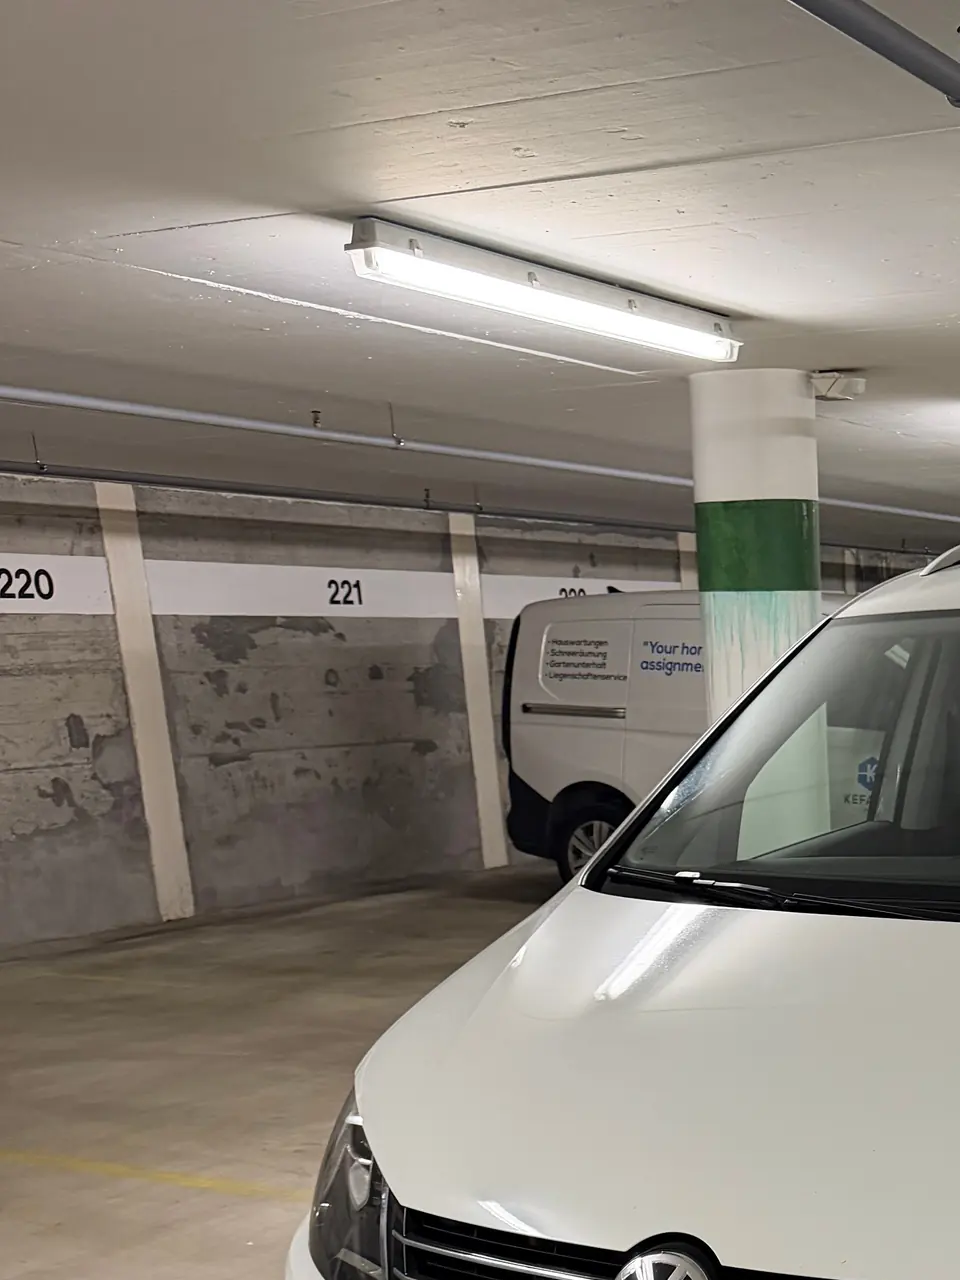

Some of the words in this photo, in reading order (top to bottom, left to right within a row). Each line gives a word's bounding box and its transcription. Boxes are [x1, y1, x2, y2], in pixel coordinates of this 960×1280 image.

[0, 568, 54, 600] 220
[327, 579, 363, 605] 221
[551, 639, 609, 649] Hauswartungen
[550, 648, 607, 660] Schneeräumung
[549, 660, 606, 669] Gartenunterhalt
[640, 657, 704, 676] assignme
[548, 671, 628, 682] Liegenschaftenservice
